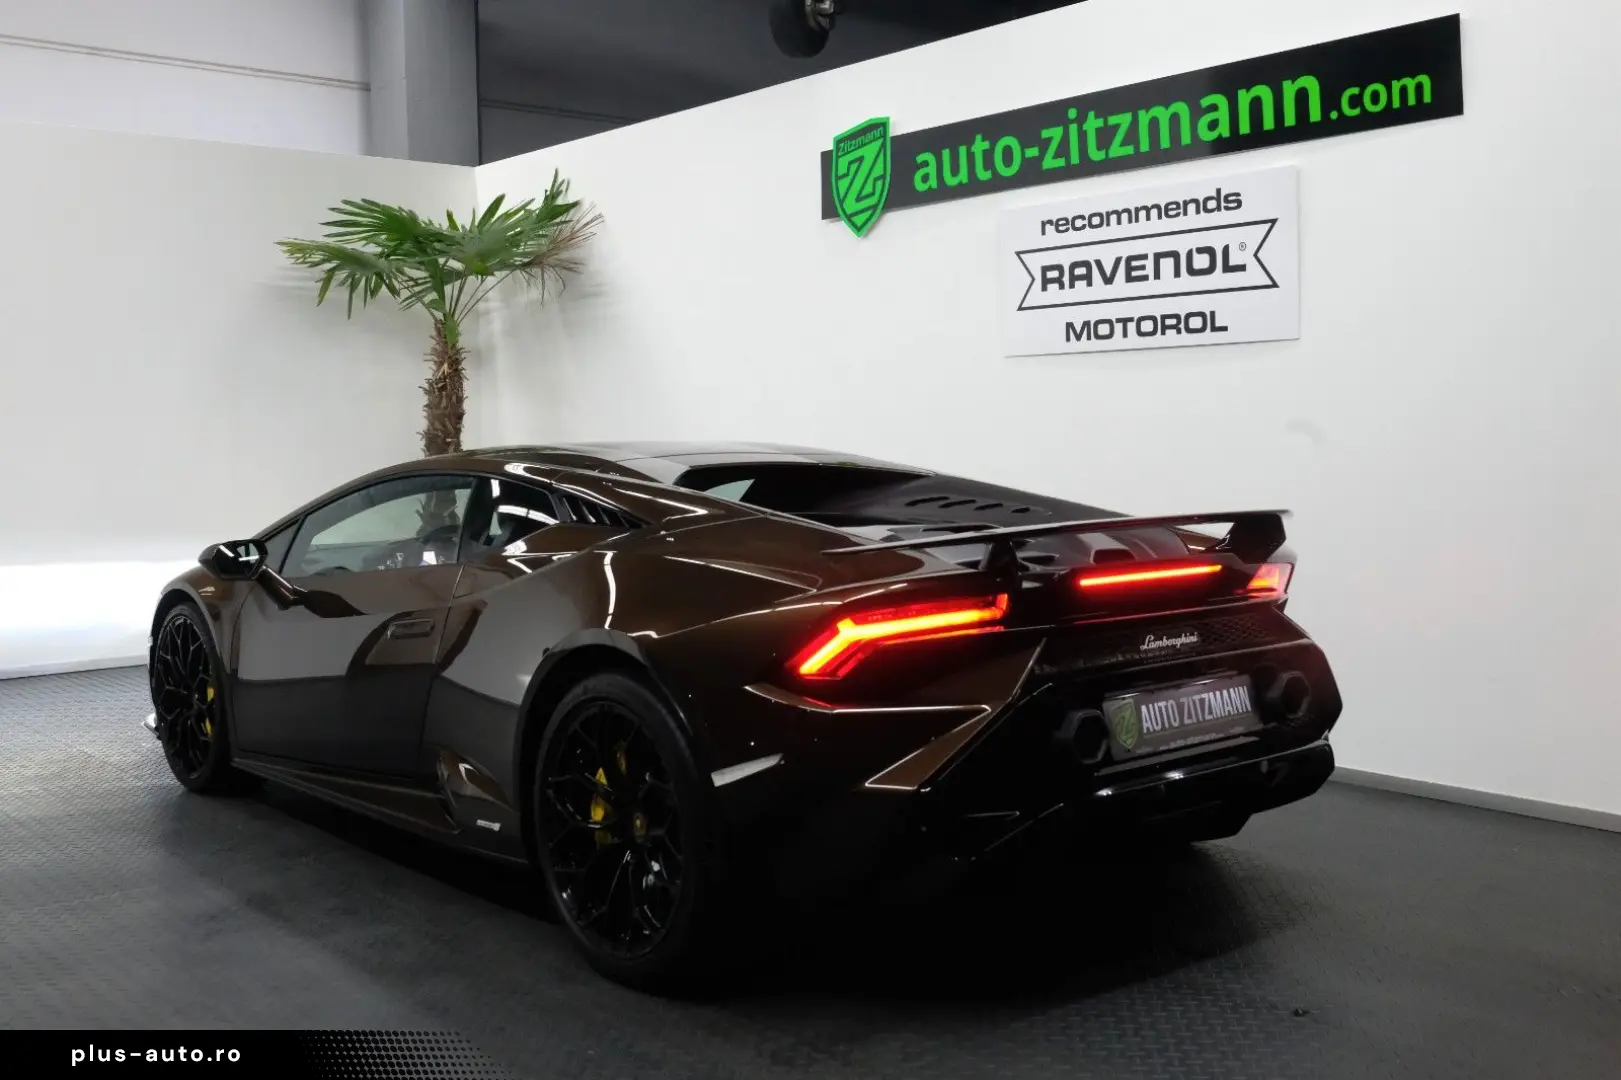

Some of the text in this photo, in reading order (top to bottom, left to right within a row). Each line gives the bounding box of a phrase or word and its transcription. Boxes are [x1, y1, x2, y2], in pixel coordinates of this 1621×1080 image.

[838, 127, 884, 155] Zitzmann
[913, 73, 1432, 193] auto-zitzmann.com
[1041, 187, 1243, 236] recommends
[1065, 310, 1229, 342] MOTOROL
[1140, 632, 1198, 650] Lamborghini
[1141, 686, 1252, 734] AUTO ZITZMANN
